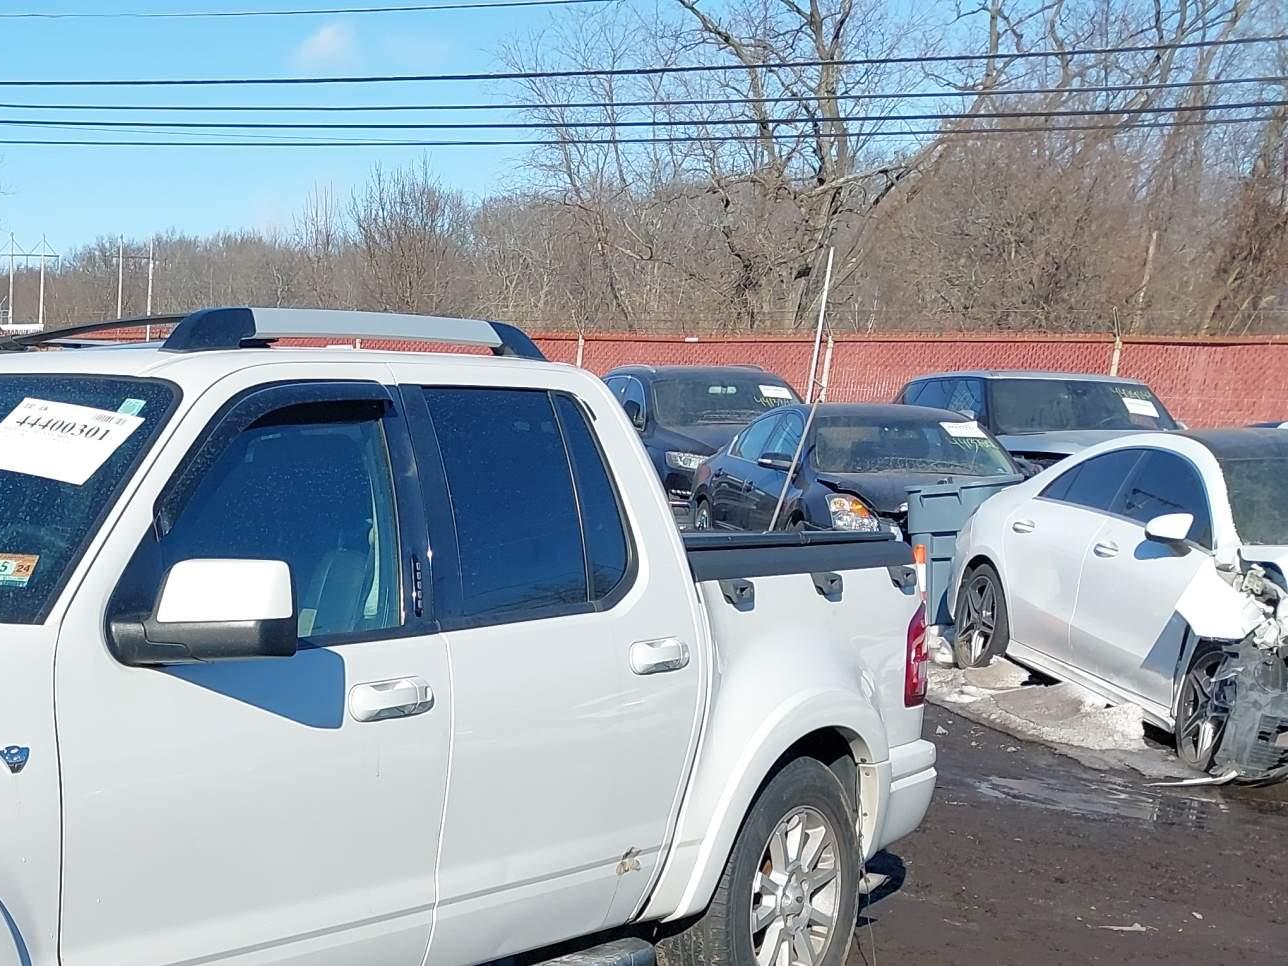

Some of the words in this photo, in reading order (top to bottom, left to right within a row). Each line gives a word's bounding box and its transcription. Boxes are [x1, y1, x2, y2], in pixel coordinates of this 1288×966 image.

[16, 415, 111, 441] 44400301
[0, 561, 12, 573] 5
[15, 564, 31, 573] 24
